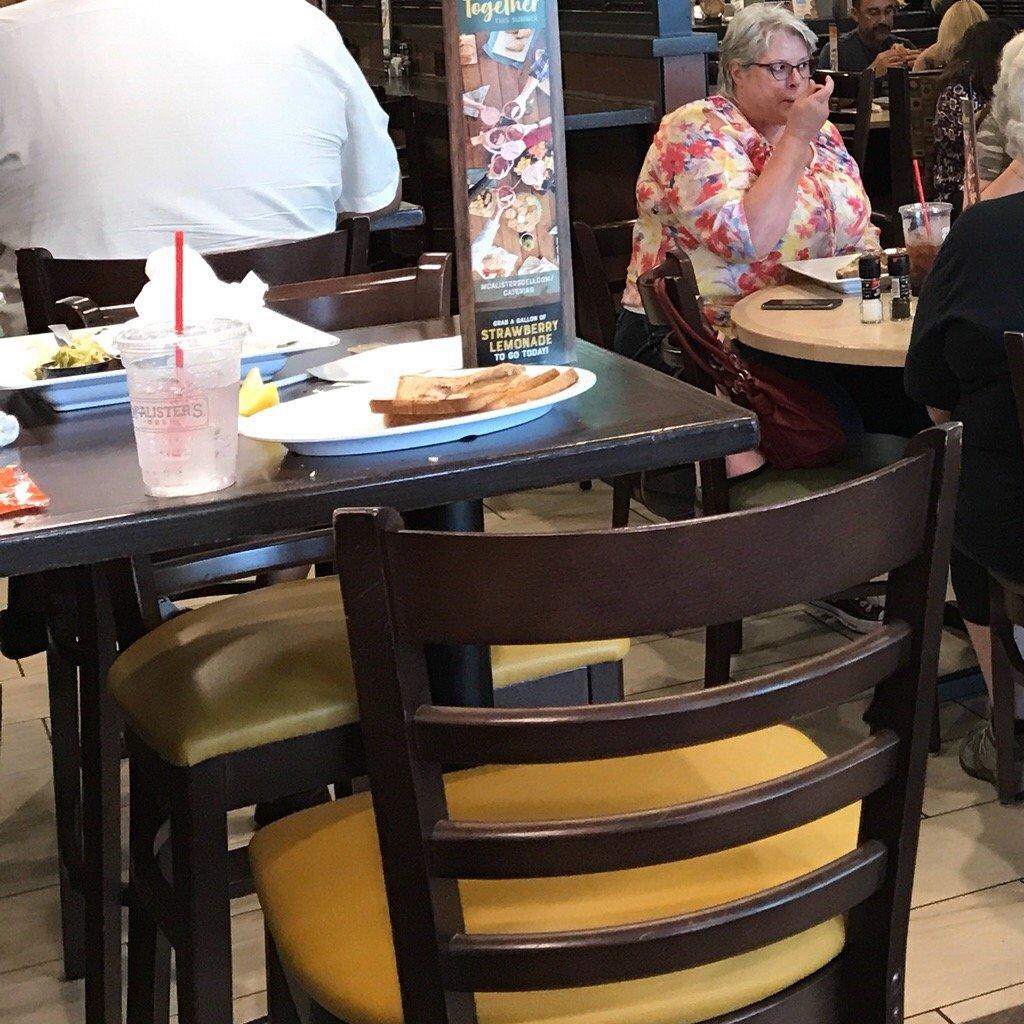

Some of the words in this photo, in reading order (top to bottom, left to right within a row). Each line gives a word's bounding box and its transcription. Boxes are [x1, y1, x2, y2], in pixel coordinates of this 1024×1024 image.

[481, 320, 559, 341] STRAWBERRY
[489, 333, 553, 353] LEMONADE
[494, 352, 506, 361] TO
[507, 351, 520, 360] GO
[522, 346, 549, 358] TODAY!
